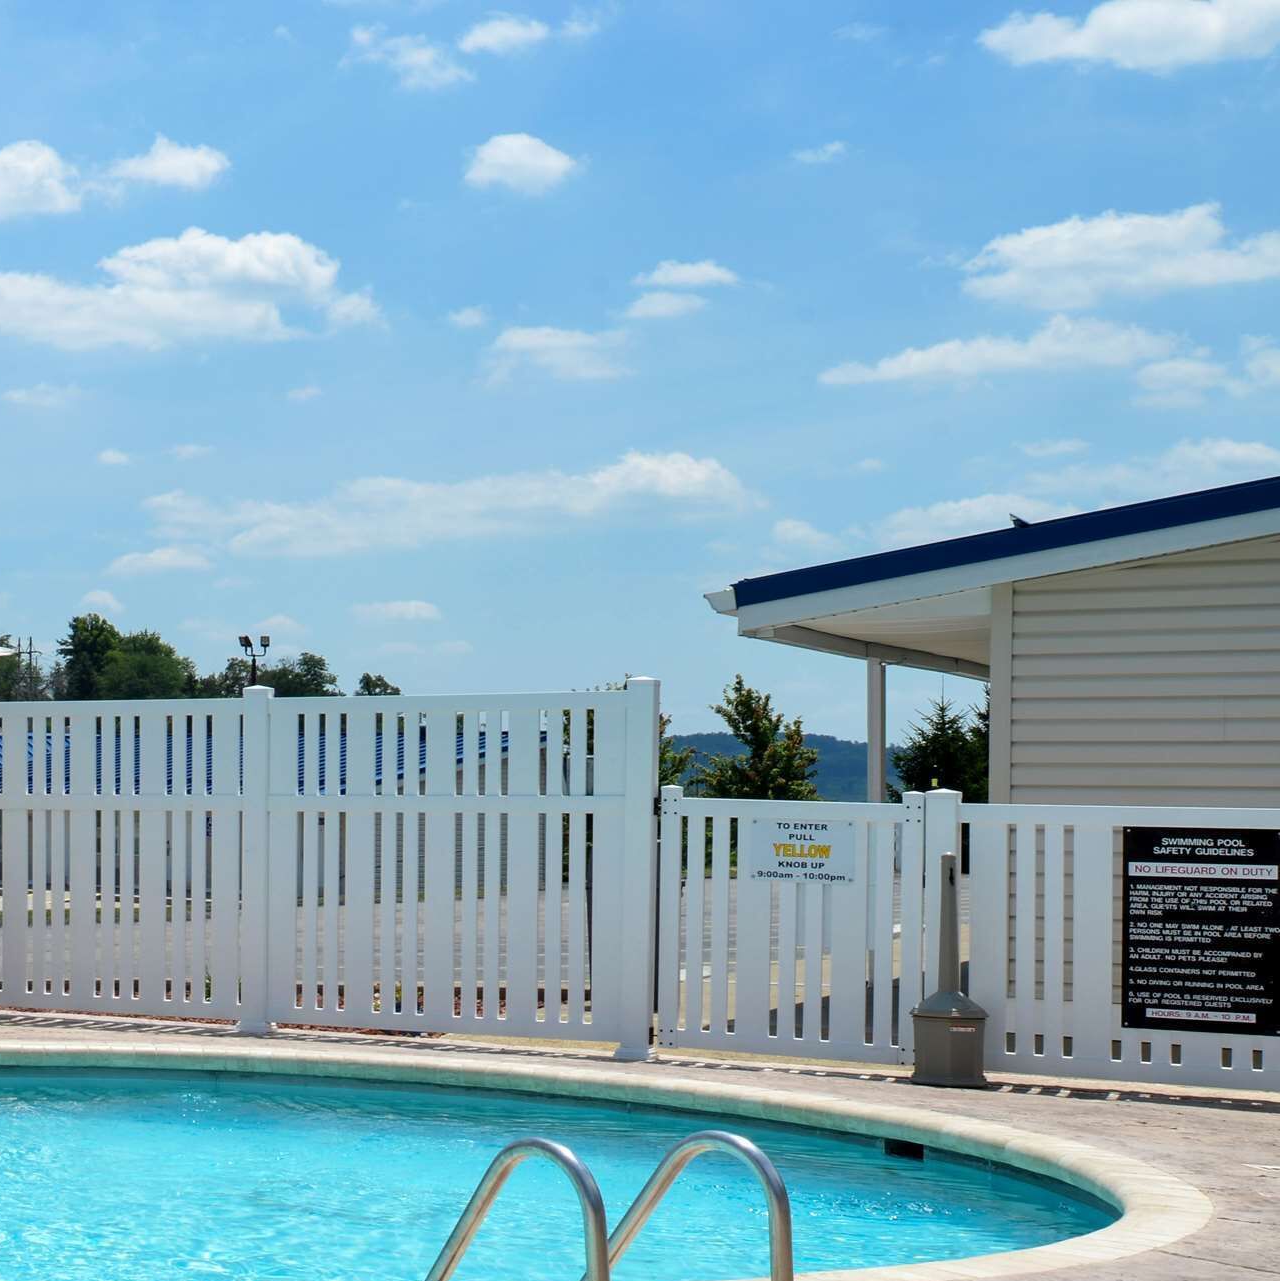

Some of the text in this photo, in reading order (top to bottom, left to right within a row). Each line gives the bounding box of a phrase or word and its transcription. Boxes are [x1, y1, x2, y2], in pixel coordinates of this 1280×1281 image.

[777, 822, 828, 831] TO ENTER
[789, 833, 815, 841] PULL
[1161, 837, 1245, 847] SWIMMING POOL
[773, 843, 832, 859] YELLOW
[1153, 846, 1255, 857] SAFETY GUIDELINES
[757, 870, 793, 879] 9:00am
[804, 872, 846, 882] 10:00pm
[1134, 865, 1273, 876] NO LIFEGUARD ON DUTY
[1159, 967, 1201, 975] CONTAINERS
[1218, 970, 1256, 978] PERMITTED
[1193, 994, 1228, 1002] RESERVED
[1230, 996, 1273, 1004] EXCLUSIVELY
